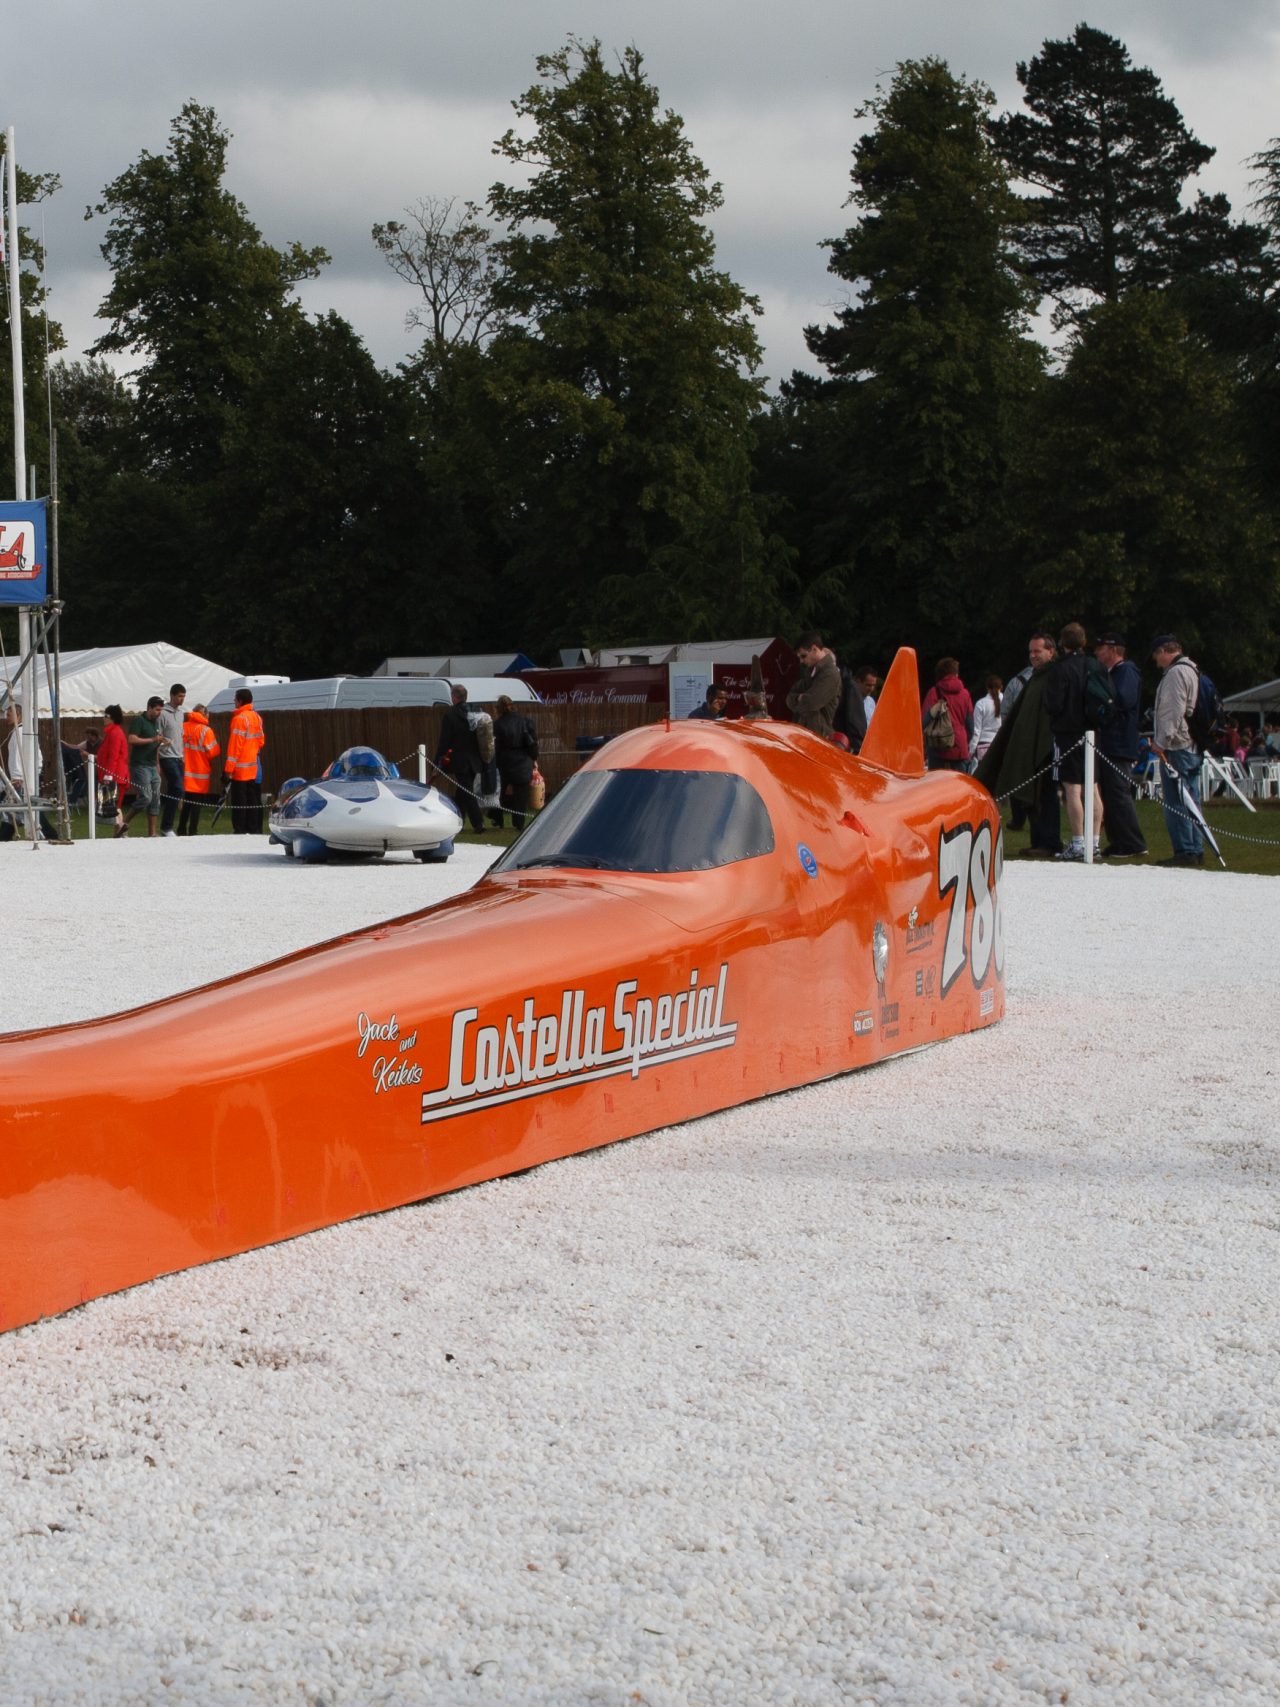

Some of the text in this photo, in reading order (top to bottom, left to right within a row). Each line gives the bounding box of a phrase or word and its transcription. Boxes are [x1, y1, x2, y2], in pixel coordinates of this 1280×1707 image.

[357, 1012, 400, 1058] Jack
[399, 1030, 417, 1053] and
[423, 963, 738, 1107] Costella Special
[372, 1056, 422, 1095] Keiko's
